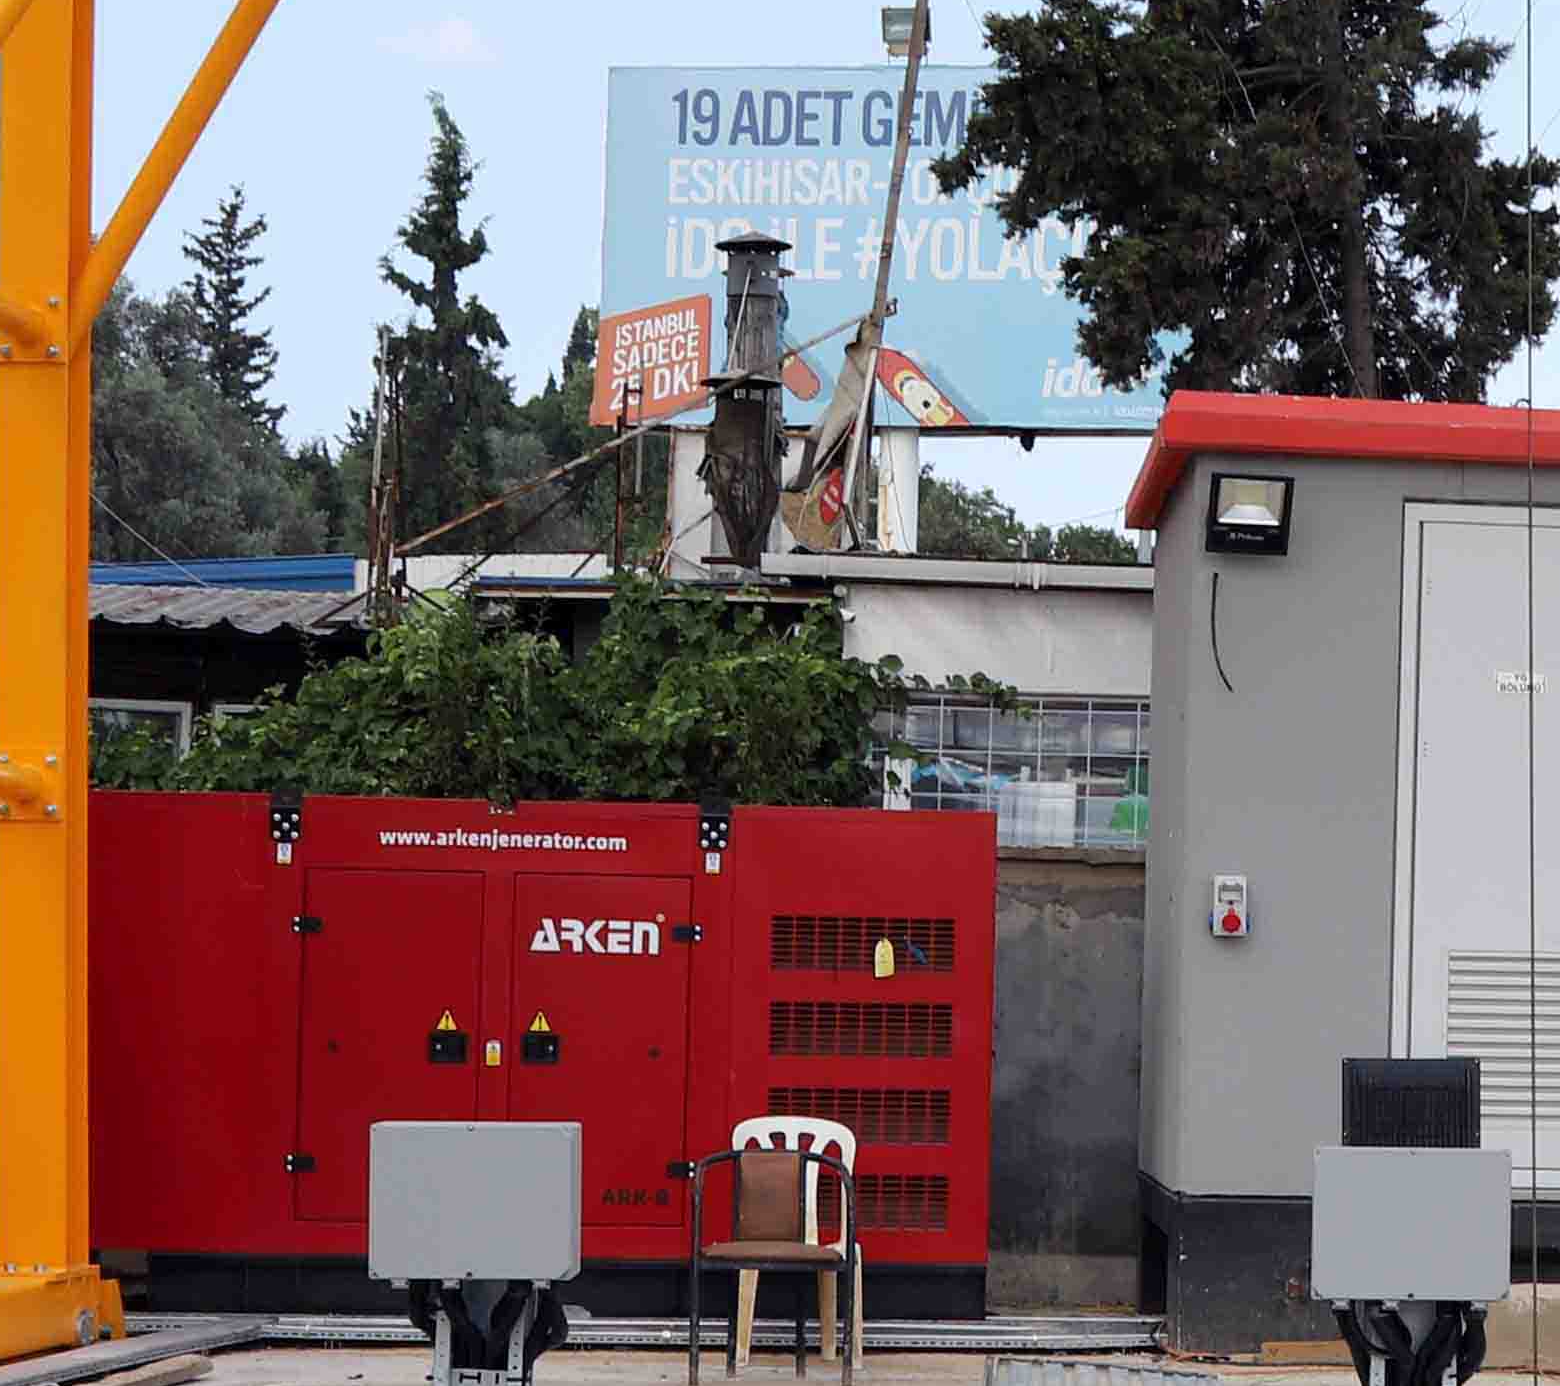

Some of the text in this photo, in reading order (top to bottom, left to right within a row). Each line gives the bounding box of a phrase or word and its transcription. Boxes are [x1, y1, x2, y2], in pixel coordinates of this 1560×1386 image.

[672, 89, 721, 147] 19
[728, 90, 853, 147] ADET
[615, 309, 699, 349] İSTANBUL
[613, 332, 699, 375] SADECE
[652, 360, 699, 400] DK!
[380, 828, 628, 851] www.arkenjenerator.com
[529, 917, 661, 955] ARKEN
